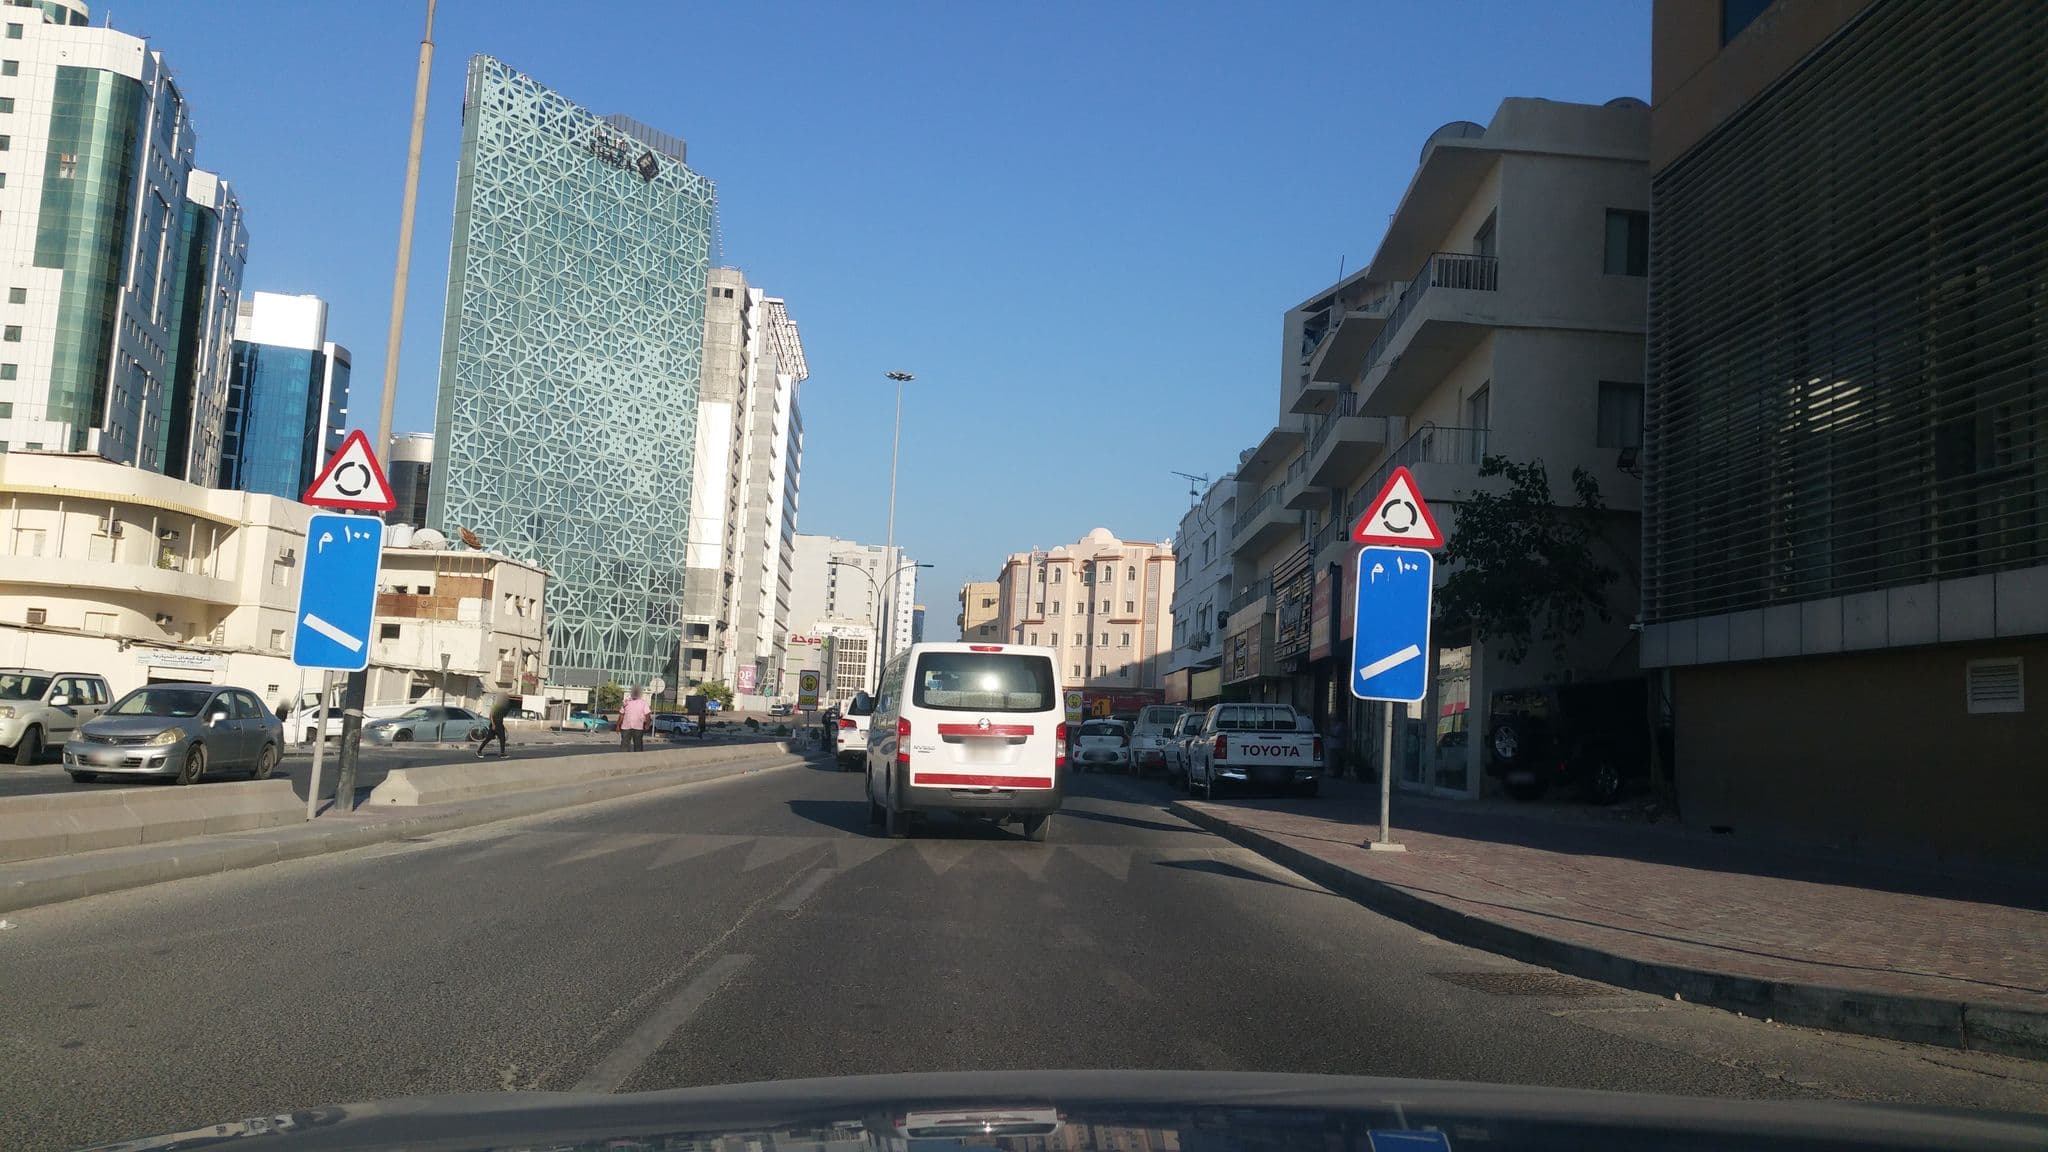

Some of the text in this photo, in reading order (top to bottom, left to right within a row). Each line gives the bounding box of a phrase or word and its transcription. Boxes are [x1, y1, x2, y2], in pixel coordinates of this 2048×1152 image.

[319, 532, 334, 554] م
[1371, 563, 1384, 584] م
[1241, 745, 1300, 757] TOYOTA
